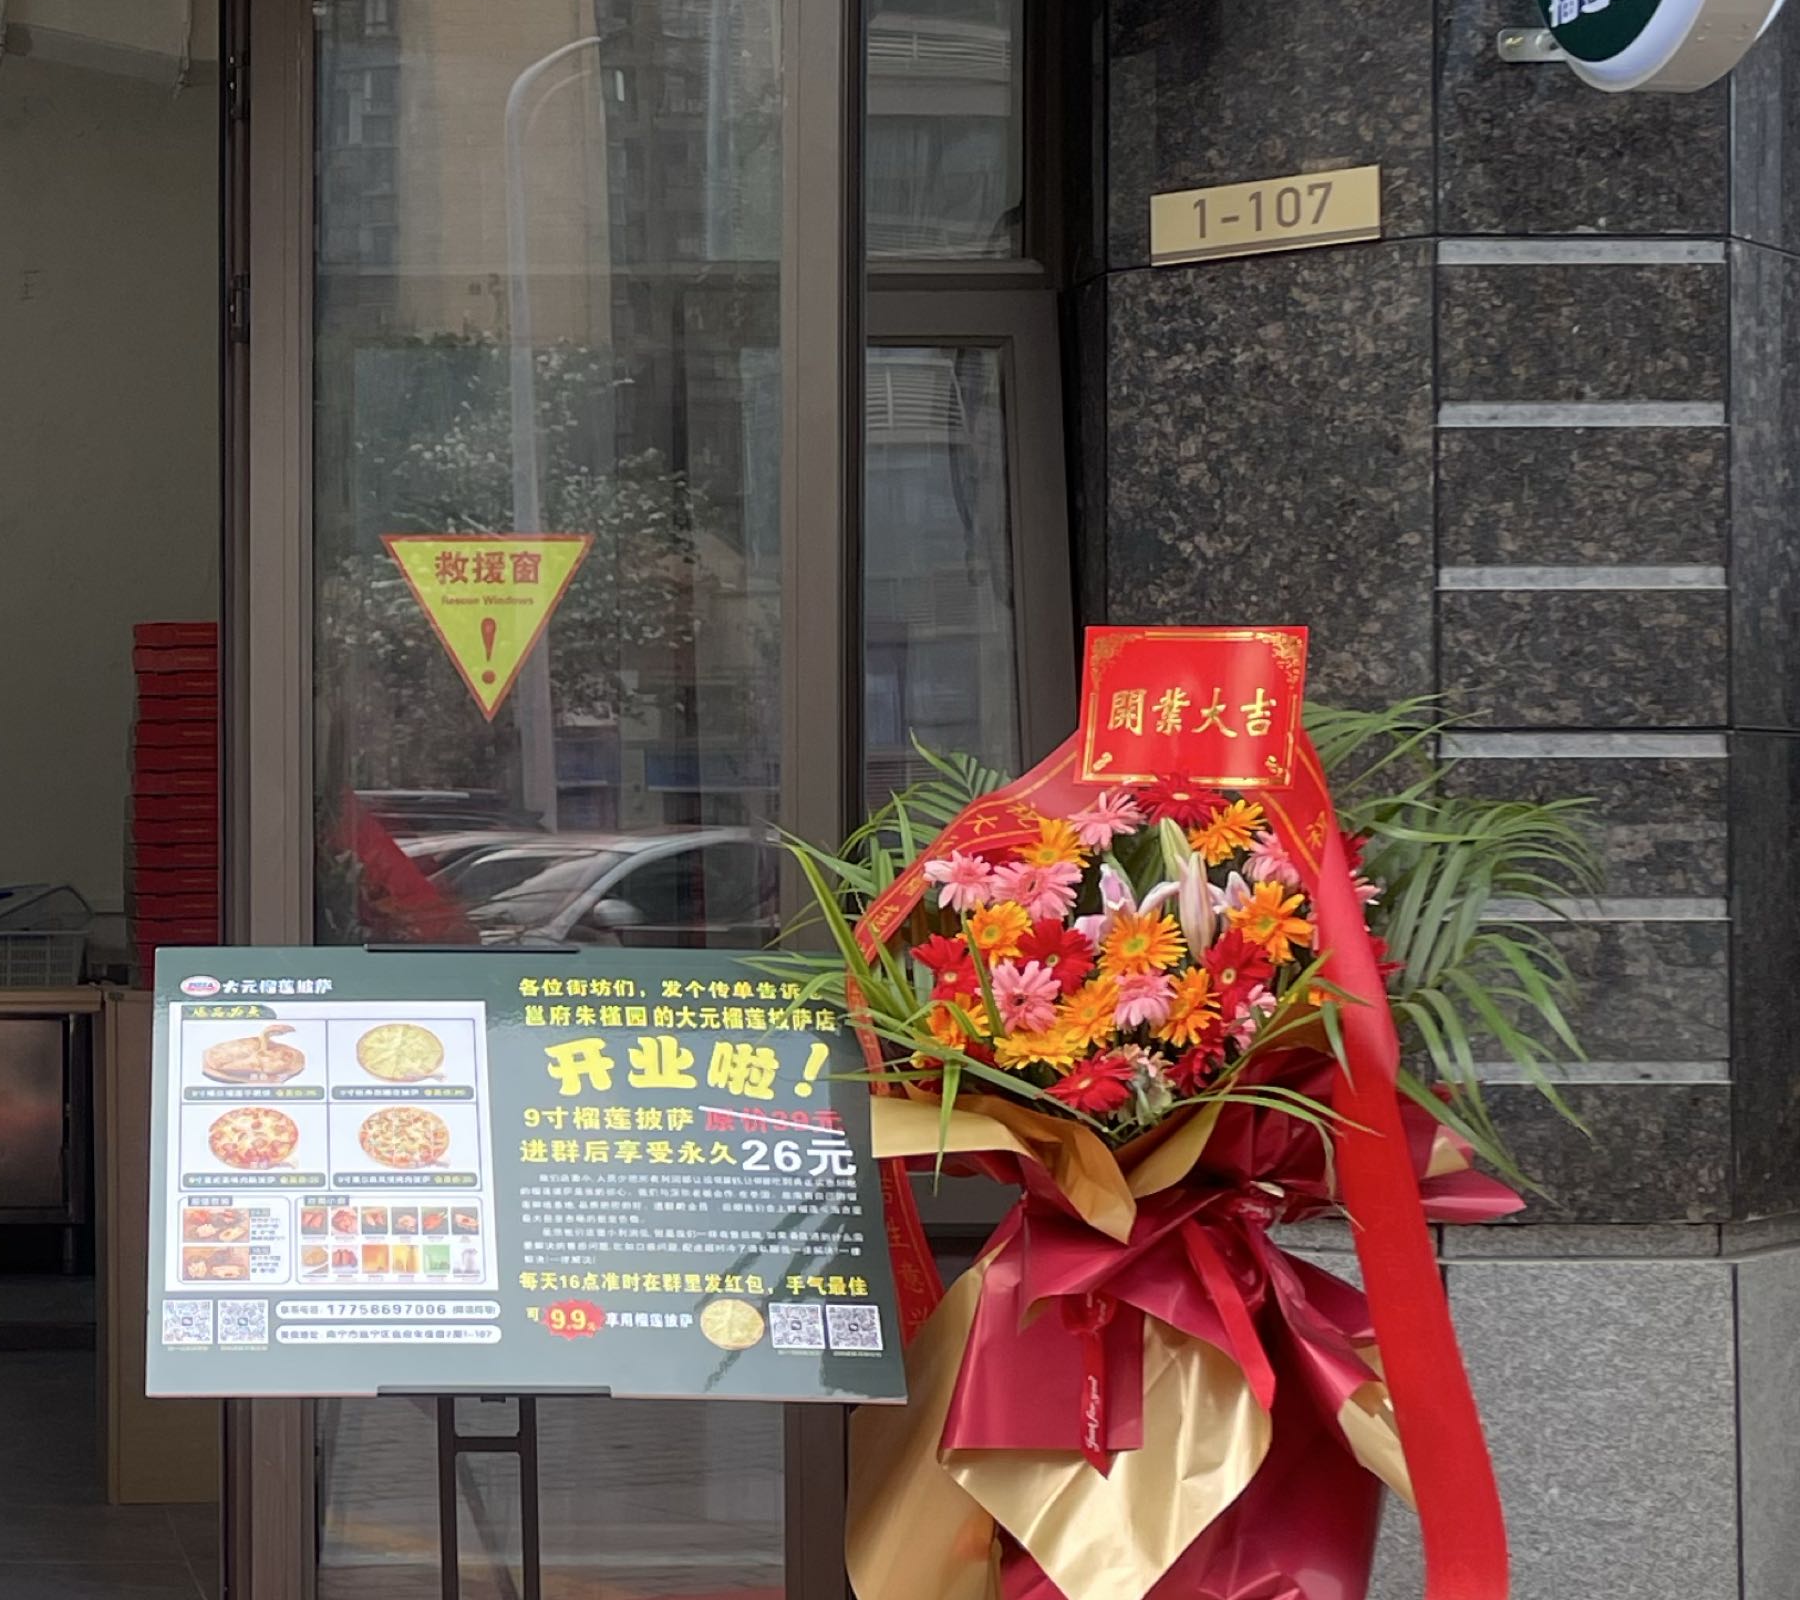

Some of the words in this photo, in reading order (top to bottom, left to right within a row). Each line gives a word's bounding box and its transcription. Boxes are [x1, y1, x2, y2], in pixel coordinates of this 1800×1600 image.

[1193, 180, 1334, 240] 1-107
[434, 550, 543, 585] 救援窗
[1107, 686, 1278, 738] 開業大吉
[523, 1106, 695, 1131] 9寸榴莲披萨
[519, 1138, 738, 1166] 进群后享受永久
[741, 1138, 858, 1177] 26元
[327, 1304, 447, 1316] 17758697006
